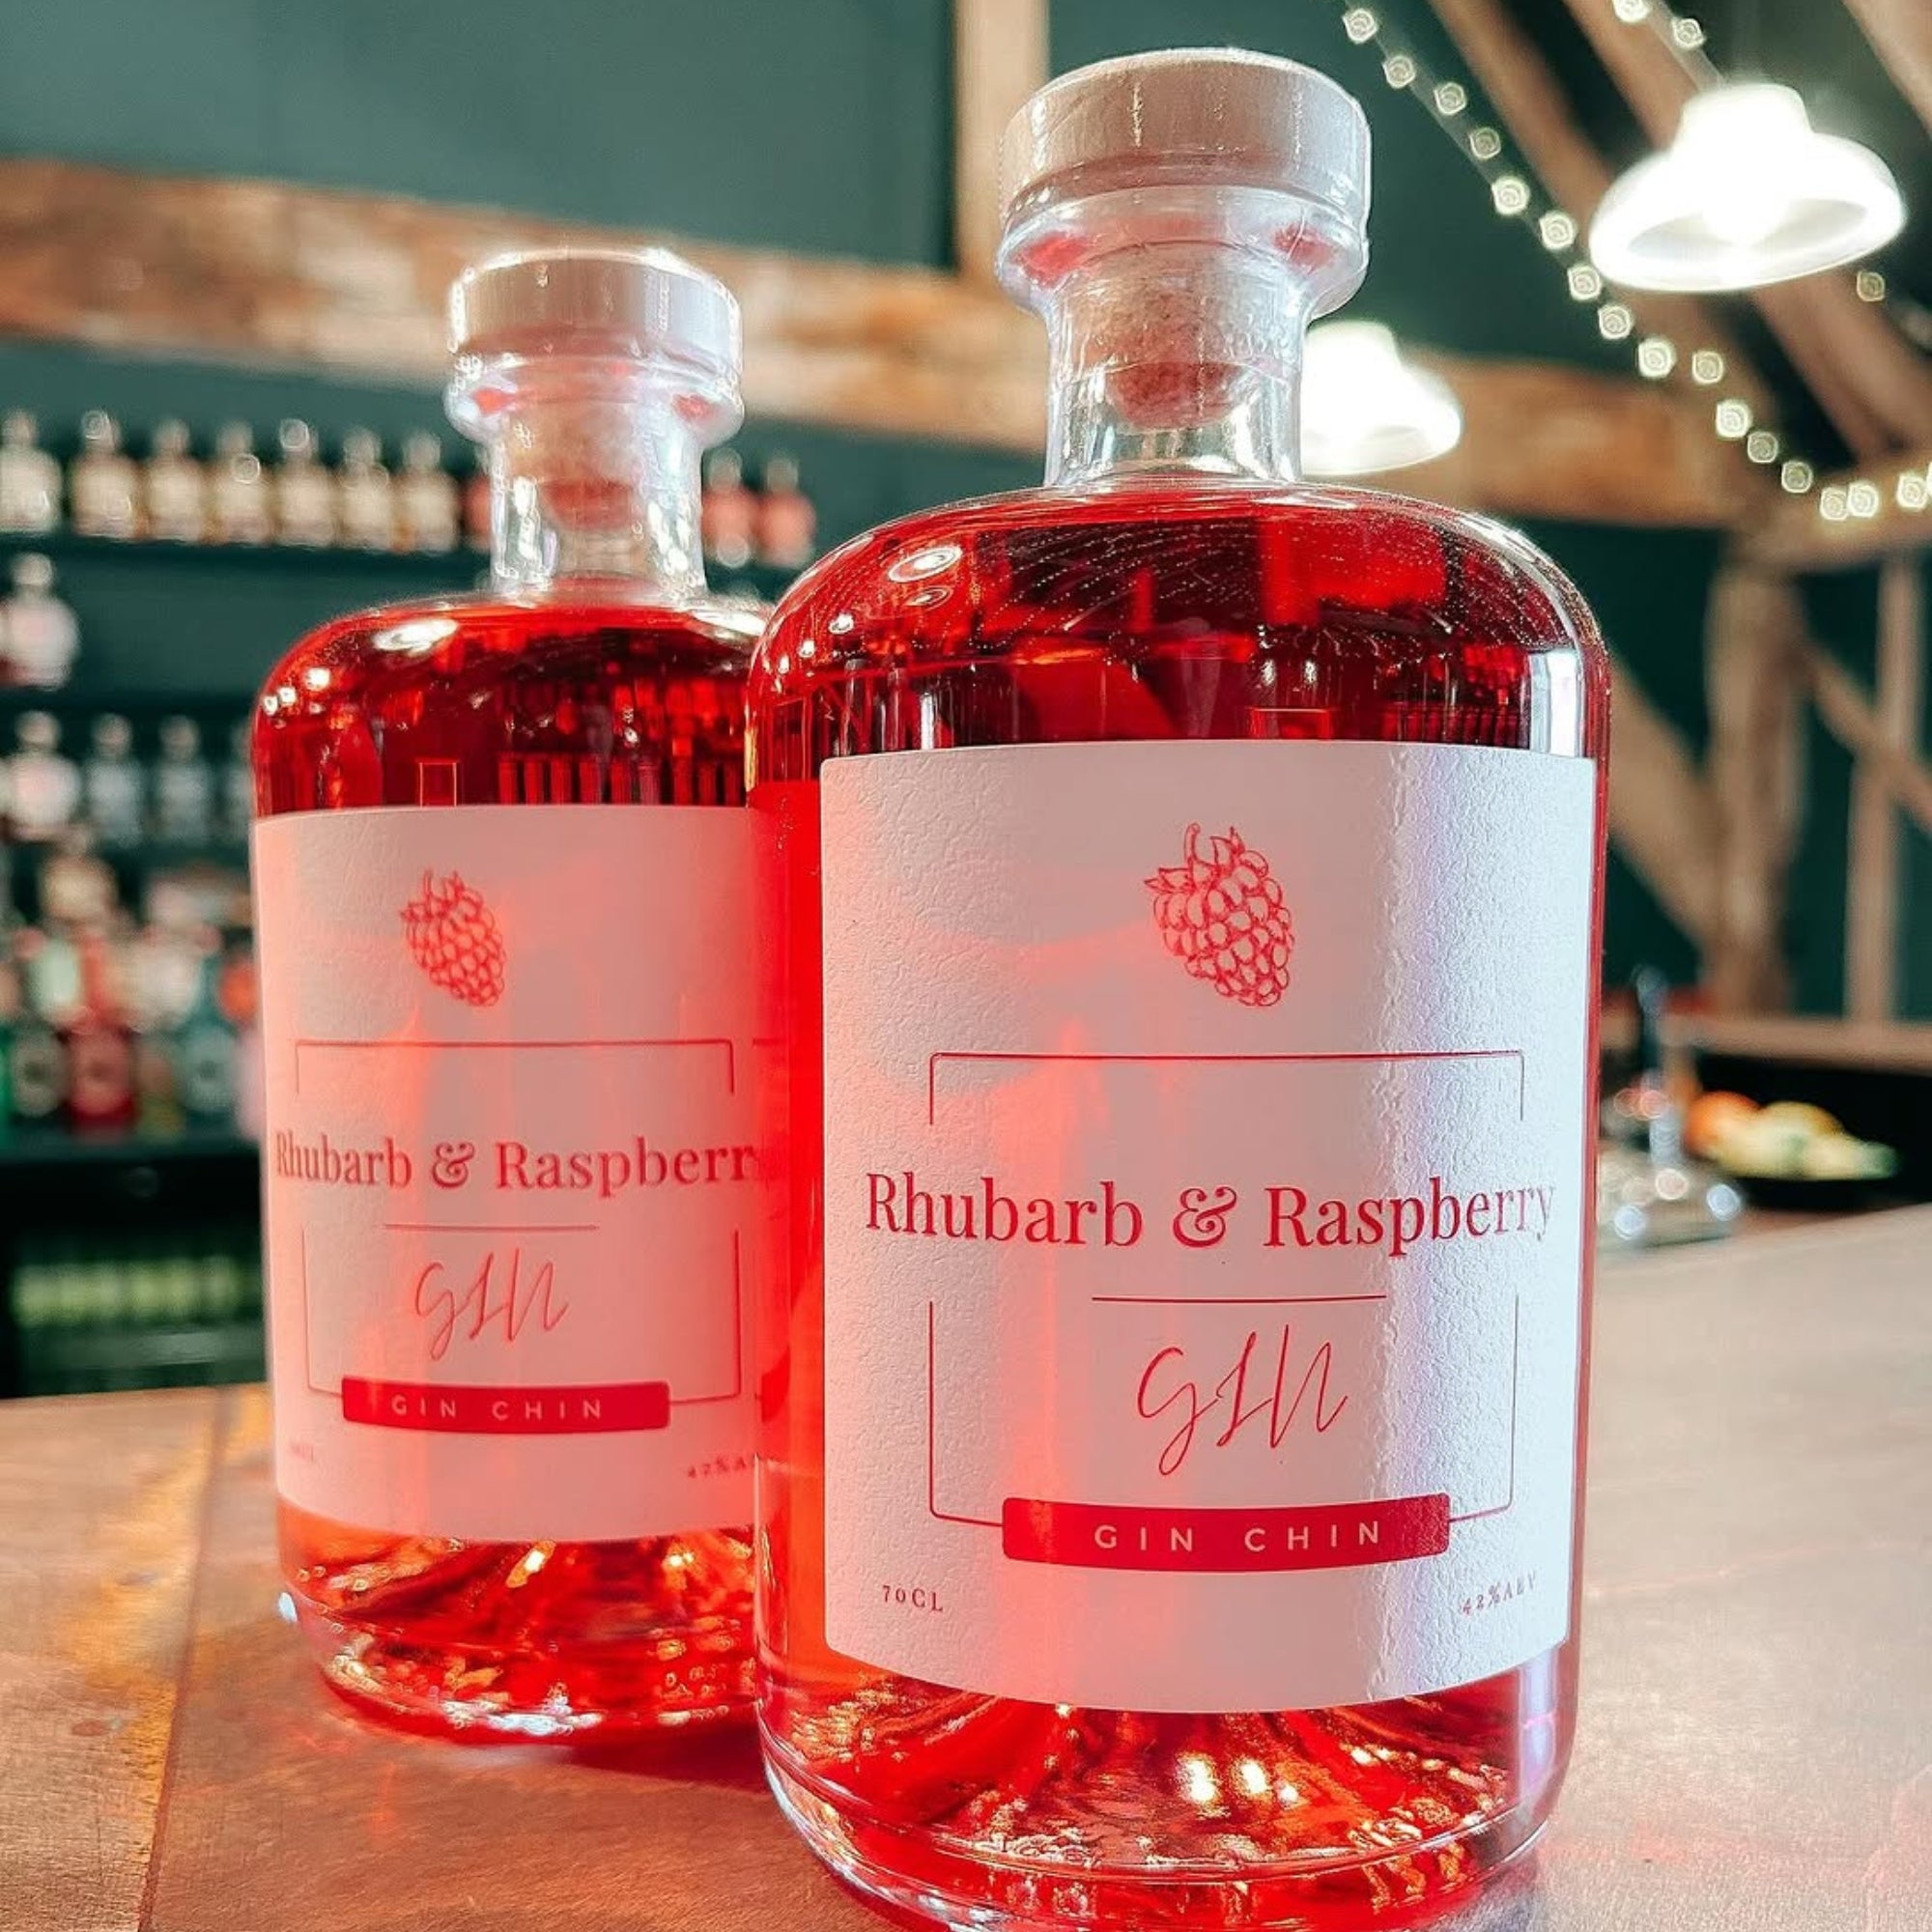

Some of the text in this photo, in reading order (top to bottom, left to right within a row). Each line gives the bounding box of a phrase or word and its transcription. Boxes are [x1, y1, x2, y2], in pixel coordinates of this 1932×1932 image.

[275, 1129, 760, 1199] Rhubarb & Raspberr
[867, 1171, 1556, 1258] Rhubarb & Raspberry
[390, 1395, 603, 1421] GIN CHIN
[1094, 1520, 1381, 1553] GIN CHIN
[881, 1584, 945, 1614] 70CL
